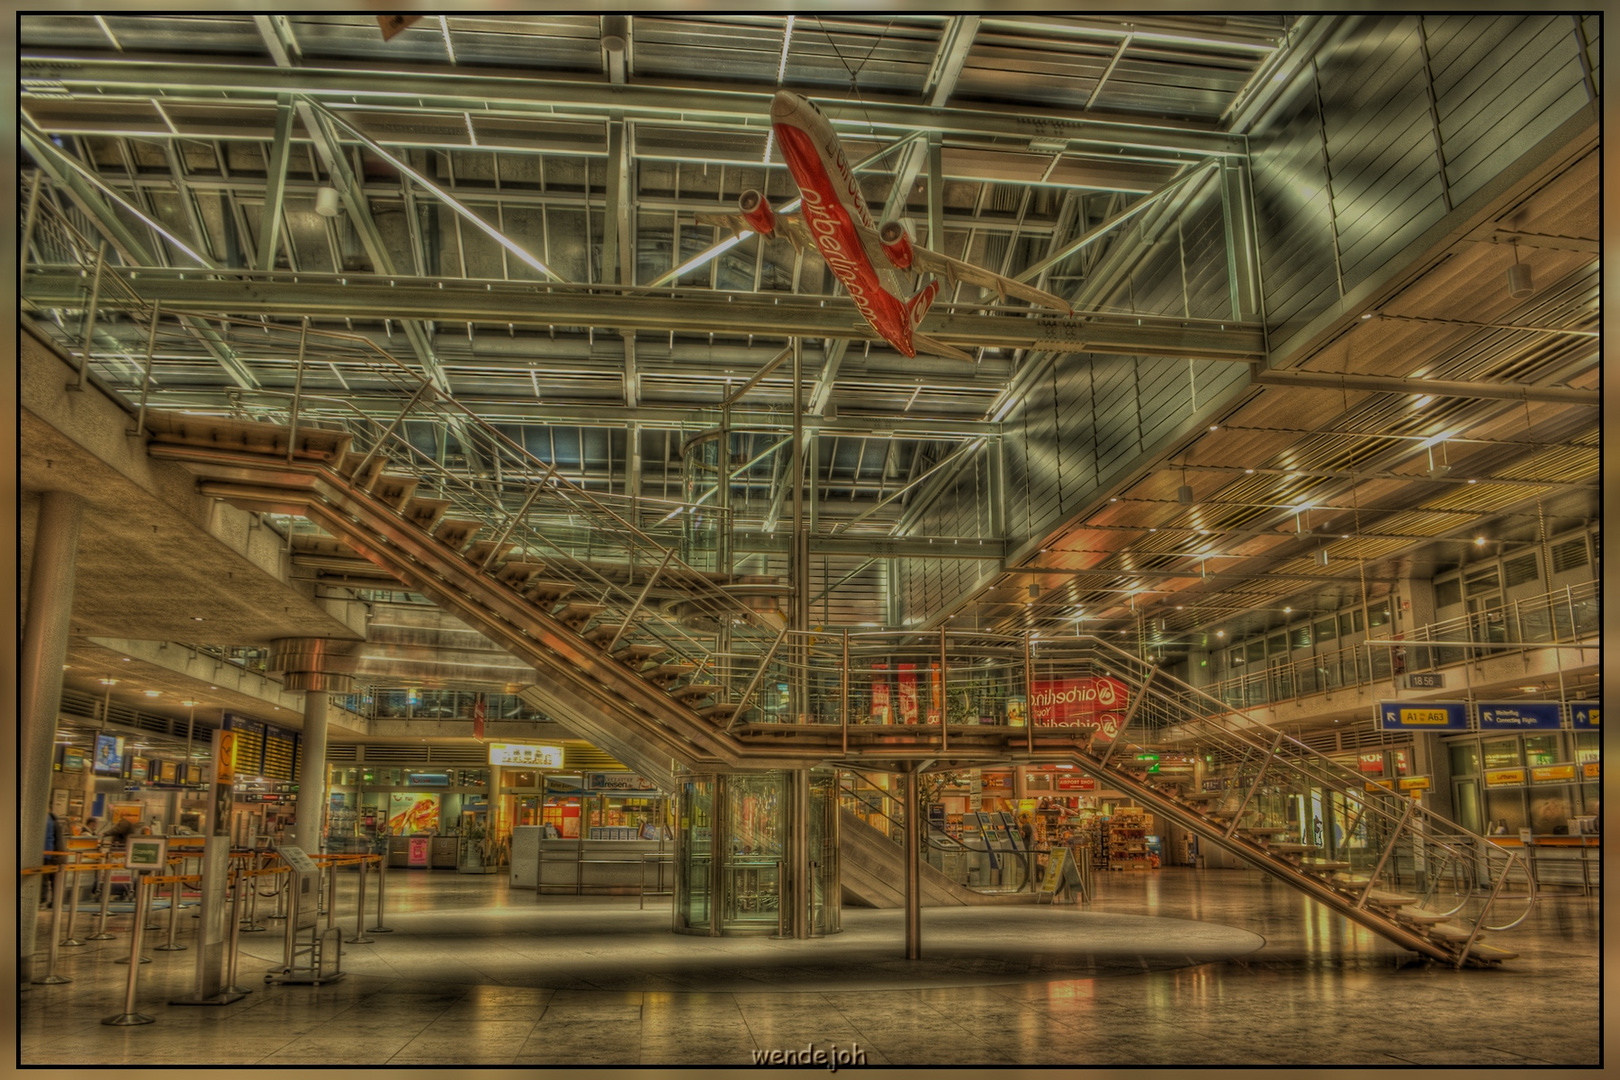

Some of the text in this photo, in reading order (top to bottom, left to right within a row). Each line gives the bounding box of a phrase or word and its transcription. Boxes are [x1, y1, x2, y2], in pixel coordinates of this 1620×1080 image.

[798, 186, 879, 323] airberlin.com
[1407, 712, 1417, 721] A1
[1427, 712, 1444, 722] A63
